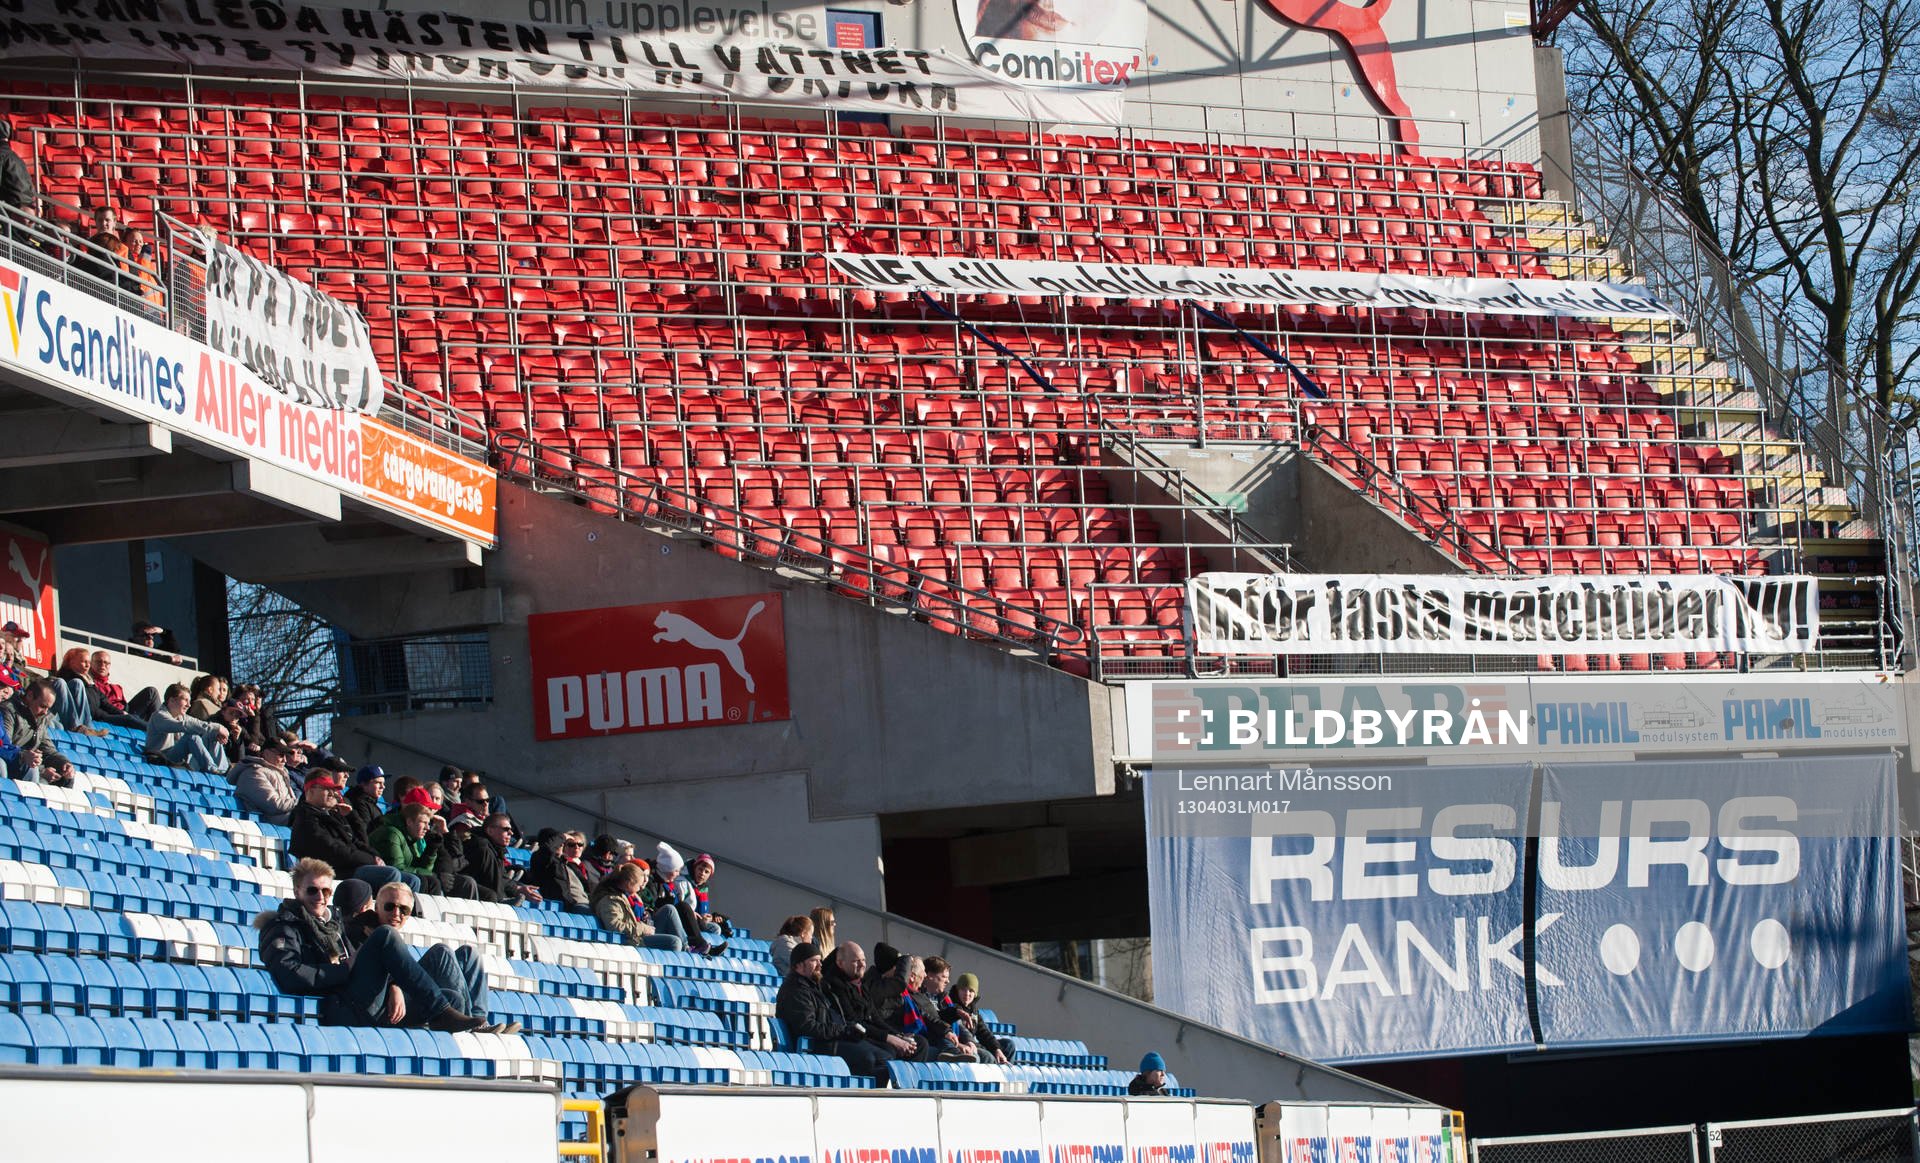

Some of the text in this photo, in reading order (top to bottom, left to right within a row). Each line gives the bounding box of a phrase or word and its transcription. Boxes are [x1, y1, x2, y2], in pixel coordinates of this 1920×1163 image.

[343, 8, 550, 55] HÄSTEN
[566, 32, 700, 70] TILL
[606, 0, 817, 41] upplevelse
[949, 261, 1025, 291] till
[36, 289, 186, 415] Scandlines
[194, 351, 272, 449] Aller
[278, 400, 361, 485] media
[383, 450, 483, 516] cargorange.se
[547, 662, 724, 735] PUMA
[1193, 684, 1470, 751] PEAB
[1536, 701, 1719, 745] PAMIL modulsystem
[1723, 697, 1897, 741] PAMIL modulsystem
[1249, 796, 1801, 905] RESURS
[1250, 913, 1566, 1005] BANK
[1709, 1130, 1721, 1142] 52
